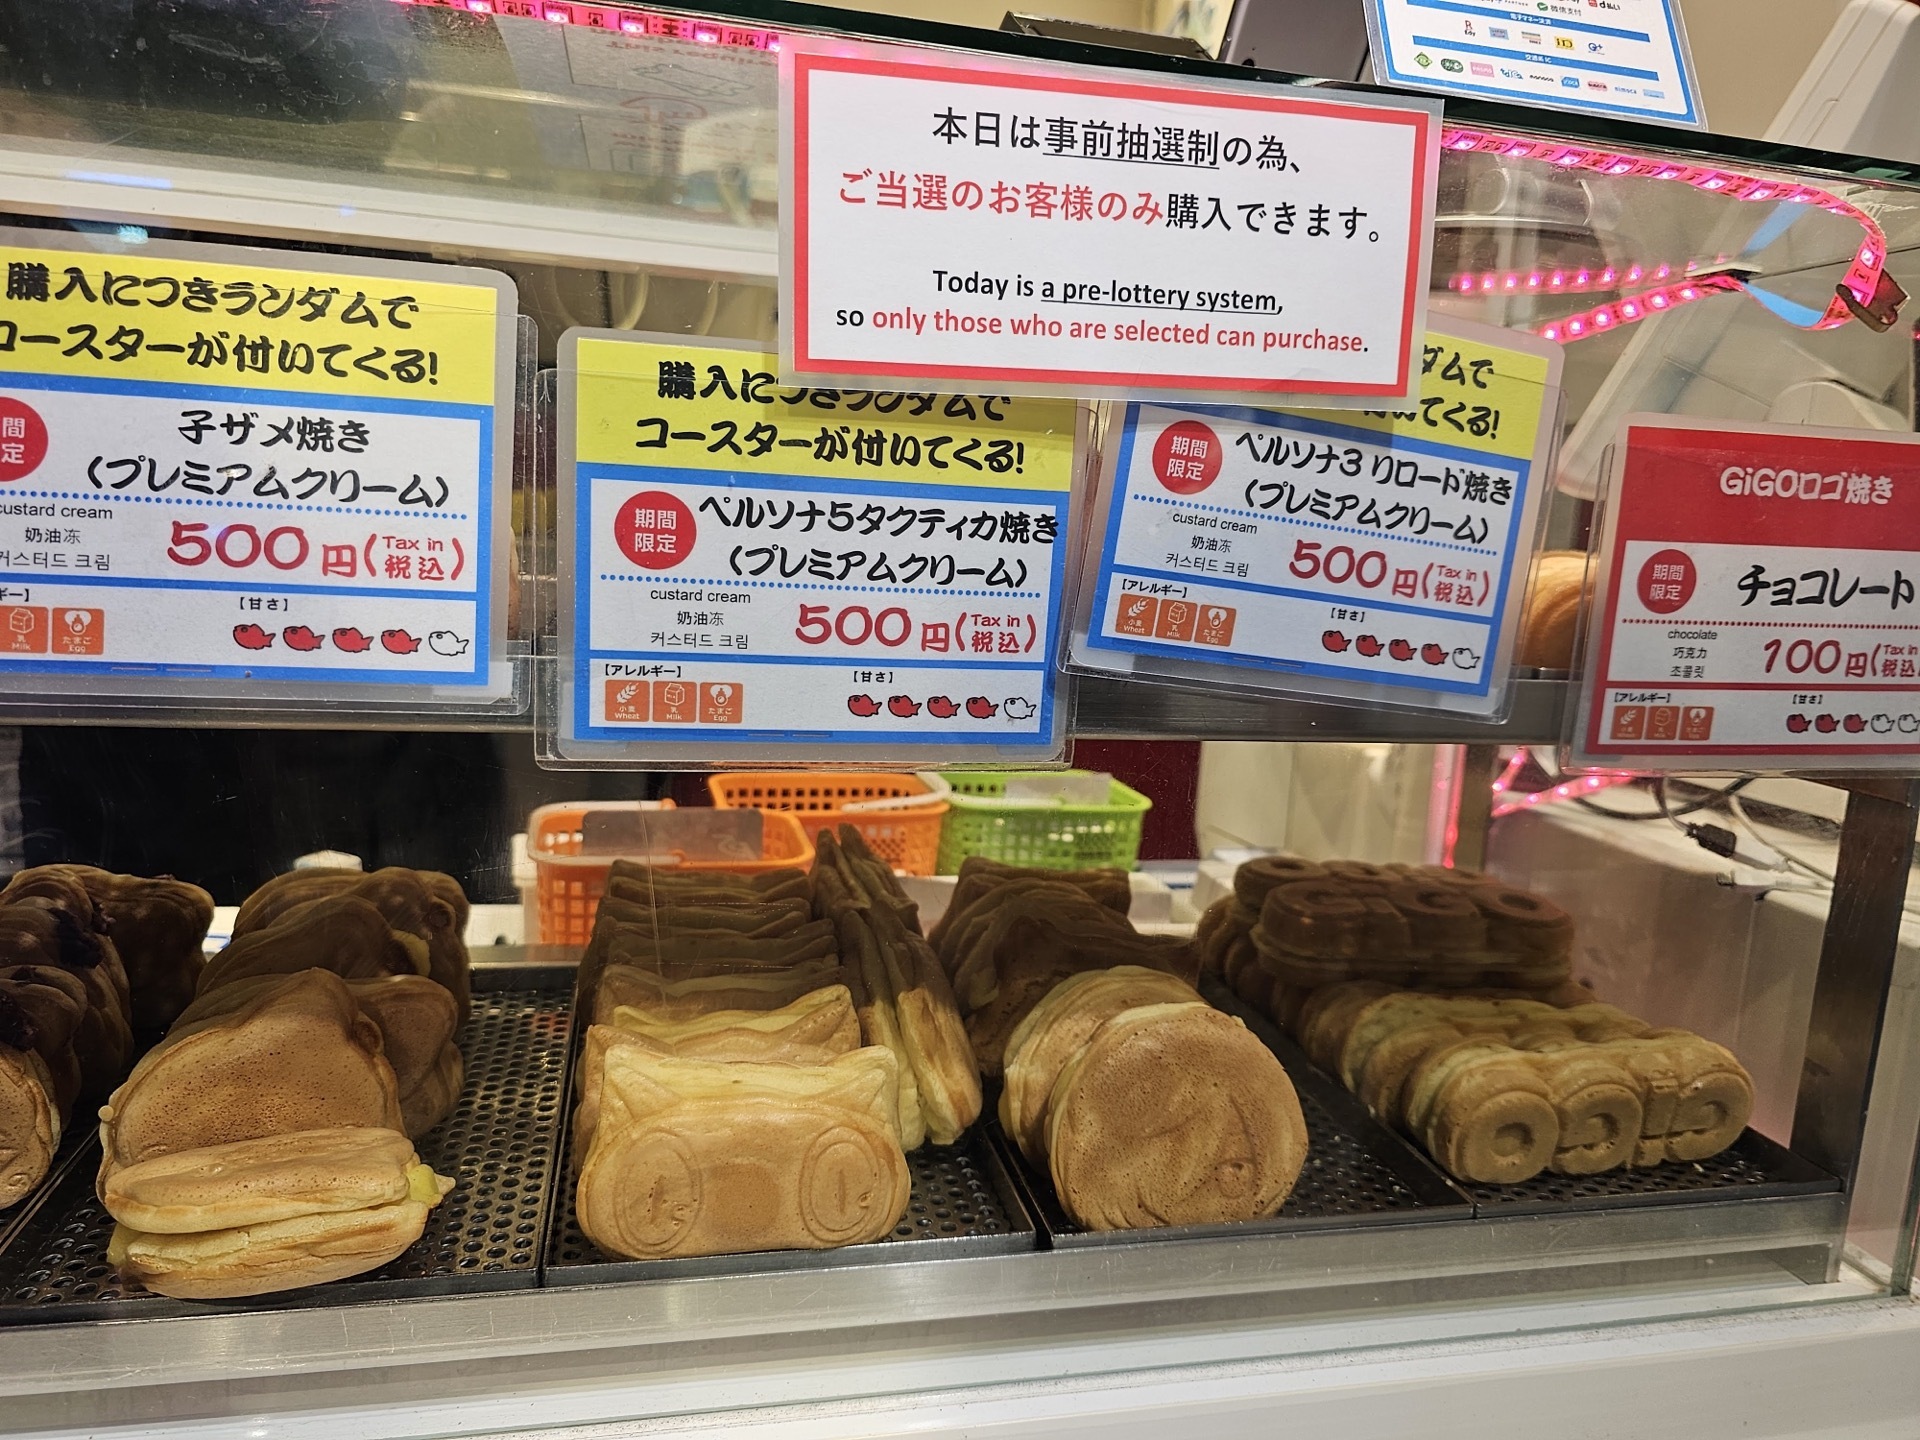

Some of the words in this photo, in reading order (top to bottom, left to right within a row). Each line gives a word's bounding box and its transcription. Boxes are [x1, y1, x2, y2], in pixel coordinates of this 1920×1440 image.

[932, 106, 1302, 173] 本日は事前抽選制の為、
[839, 168, 1381, 243] ご当選のお客様のみ購入できます。
[7, 262, 420, 330] 購入につきランダムで
[933, 270, 1008, 300] Today
[1016, 275, 1034, 296] is
[1042, 282, 1054, 298] a
[1063, 278, 1189, 311] pre-lottery
[1196, 290, 1284, 317] system,
[836, 309, 864, 327] so
[872, 307, 926, 336] only
[933, 308, 1002, 334] those
[1010, 311, 1062, 337] who
[1069, 319, 1107, 340] are
[1114, 318, 1209, 346] selected
[1216, 327, 1255, 347] can
[1262, 325, 1368, 355] purchase.
[178, 409, 371, 453] 子ザメ焼き
[636, 418, 1024, 474] コースターが付いてくる!
[1171, 435, 1207, 457] 期間
[1167, 459, 1205, 481] 限定
[61, 507, 112, 519] cream
[635, 508, 677, 531] 期間
[700, 496, 1059, 544] ペルソナ5タクティカ焼き
[1172, 513, 1217, 530] custard
[1221, 519, 1257, 535] cream
[25, 527, 81, 544] 奶油冻
[635, 533, 677, 554] 限定
[1190, 535, 1232, 553] 奶油冻
[75, 554, 110, 571] 크림
[1165, 552, 1218, 573] 커스터드
[1222, 560, 1249, 578] 크림
[1652, 564, 1684, 580] 期間
[650, 588, 702, 602] custard
[708, 593, 751, 604] cream
[1649, 584, 1681, 601] 限定
[1737, 564, 1915, 610] チョコレート
[677, 611, 724, 627] 奶油冻
[1124, 625, 1145, 634] Wheat
[1667, 629, 1718, 640] chocolate
[68, 645, 86, 653] Egg
[650, 631, 714, 648] 커스터드
[720, 633, 748, 650] 크림
[1206, 636, 1218, 644] Egg
[1672, 646, 1707, 659] 巧克力
[1670, 665, 1704, 679] 초콜릿
[615, 712, 640, 720] Wheat
